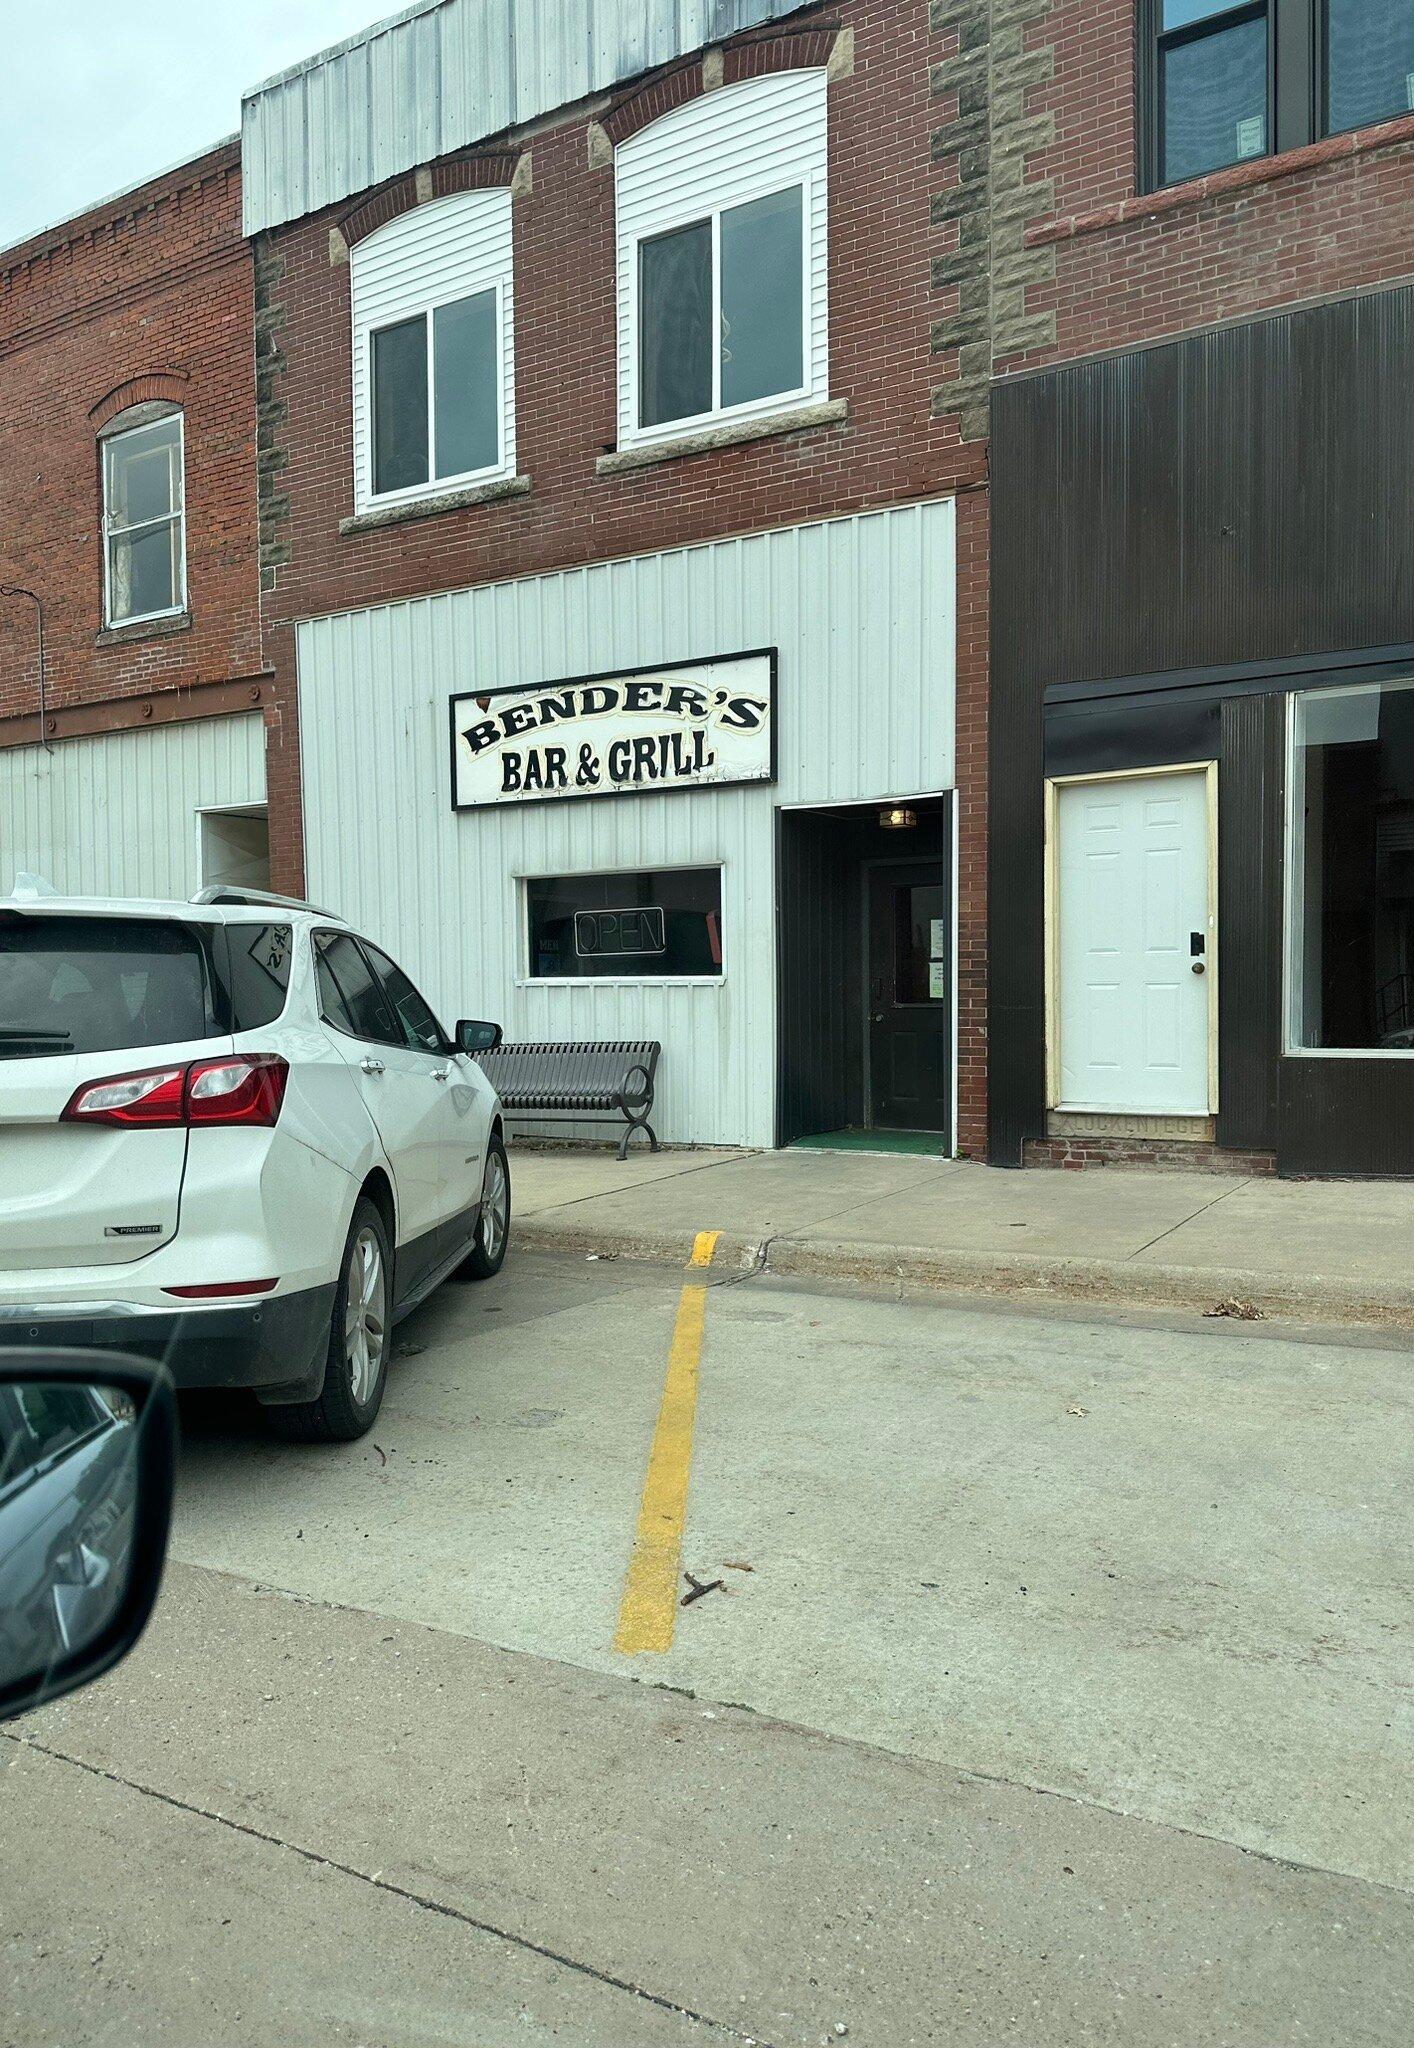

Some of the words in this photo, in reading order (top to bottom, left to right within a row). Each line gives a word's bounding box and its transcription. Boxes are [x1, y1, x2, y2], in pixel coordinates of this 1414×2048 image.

[461, 682, 768, 754] BENDER'S
[501, 747, 568, 792] BAR
[575, 743, 600, 786] &
[608, 730, 715, 783] GRILL
[578, 912, 662, 951] OPEN
[120, 1226, 159, 1234] PREMIER
